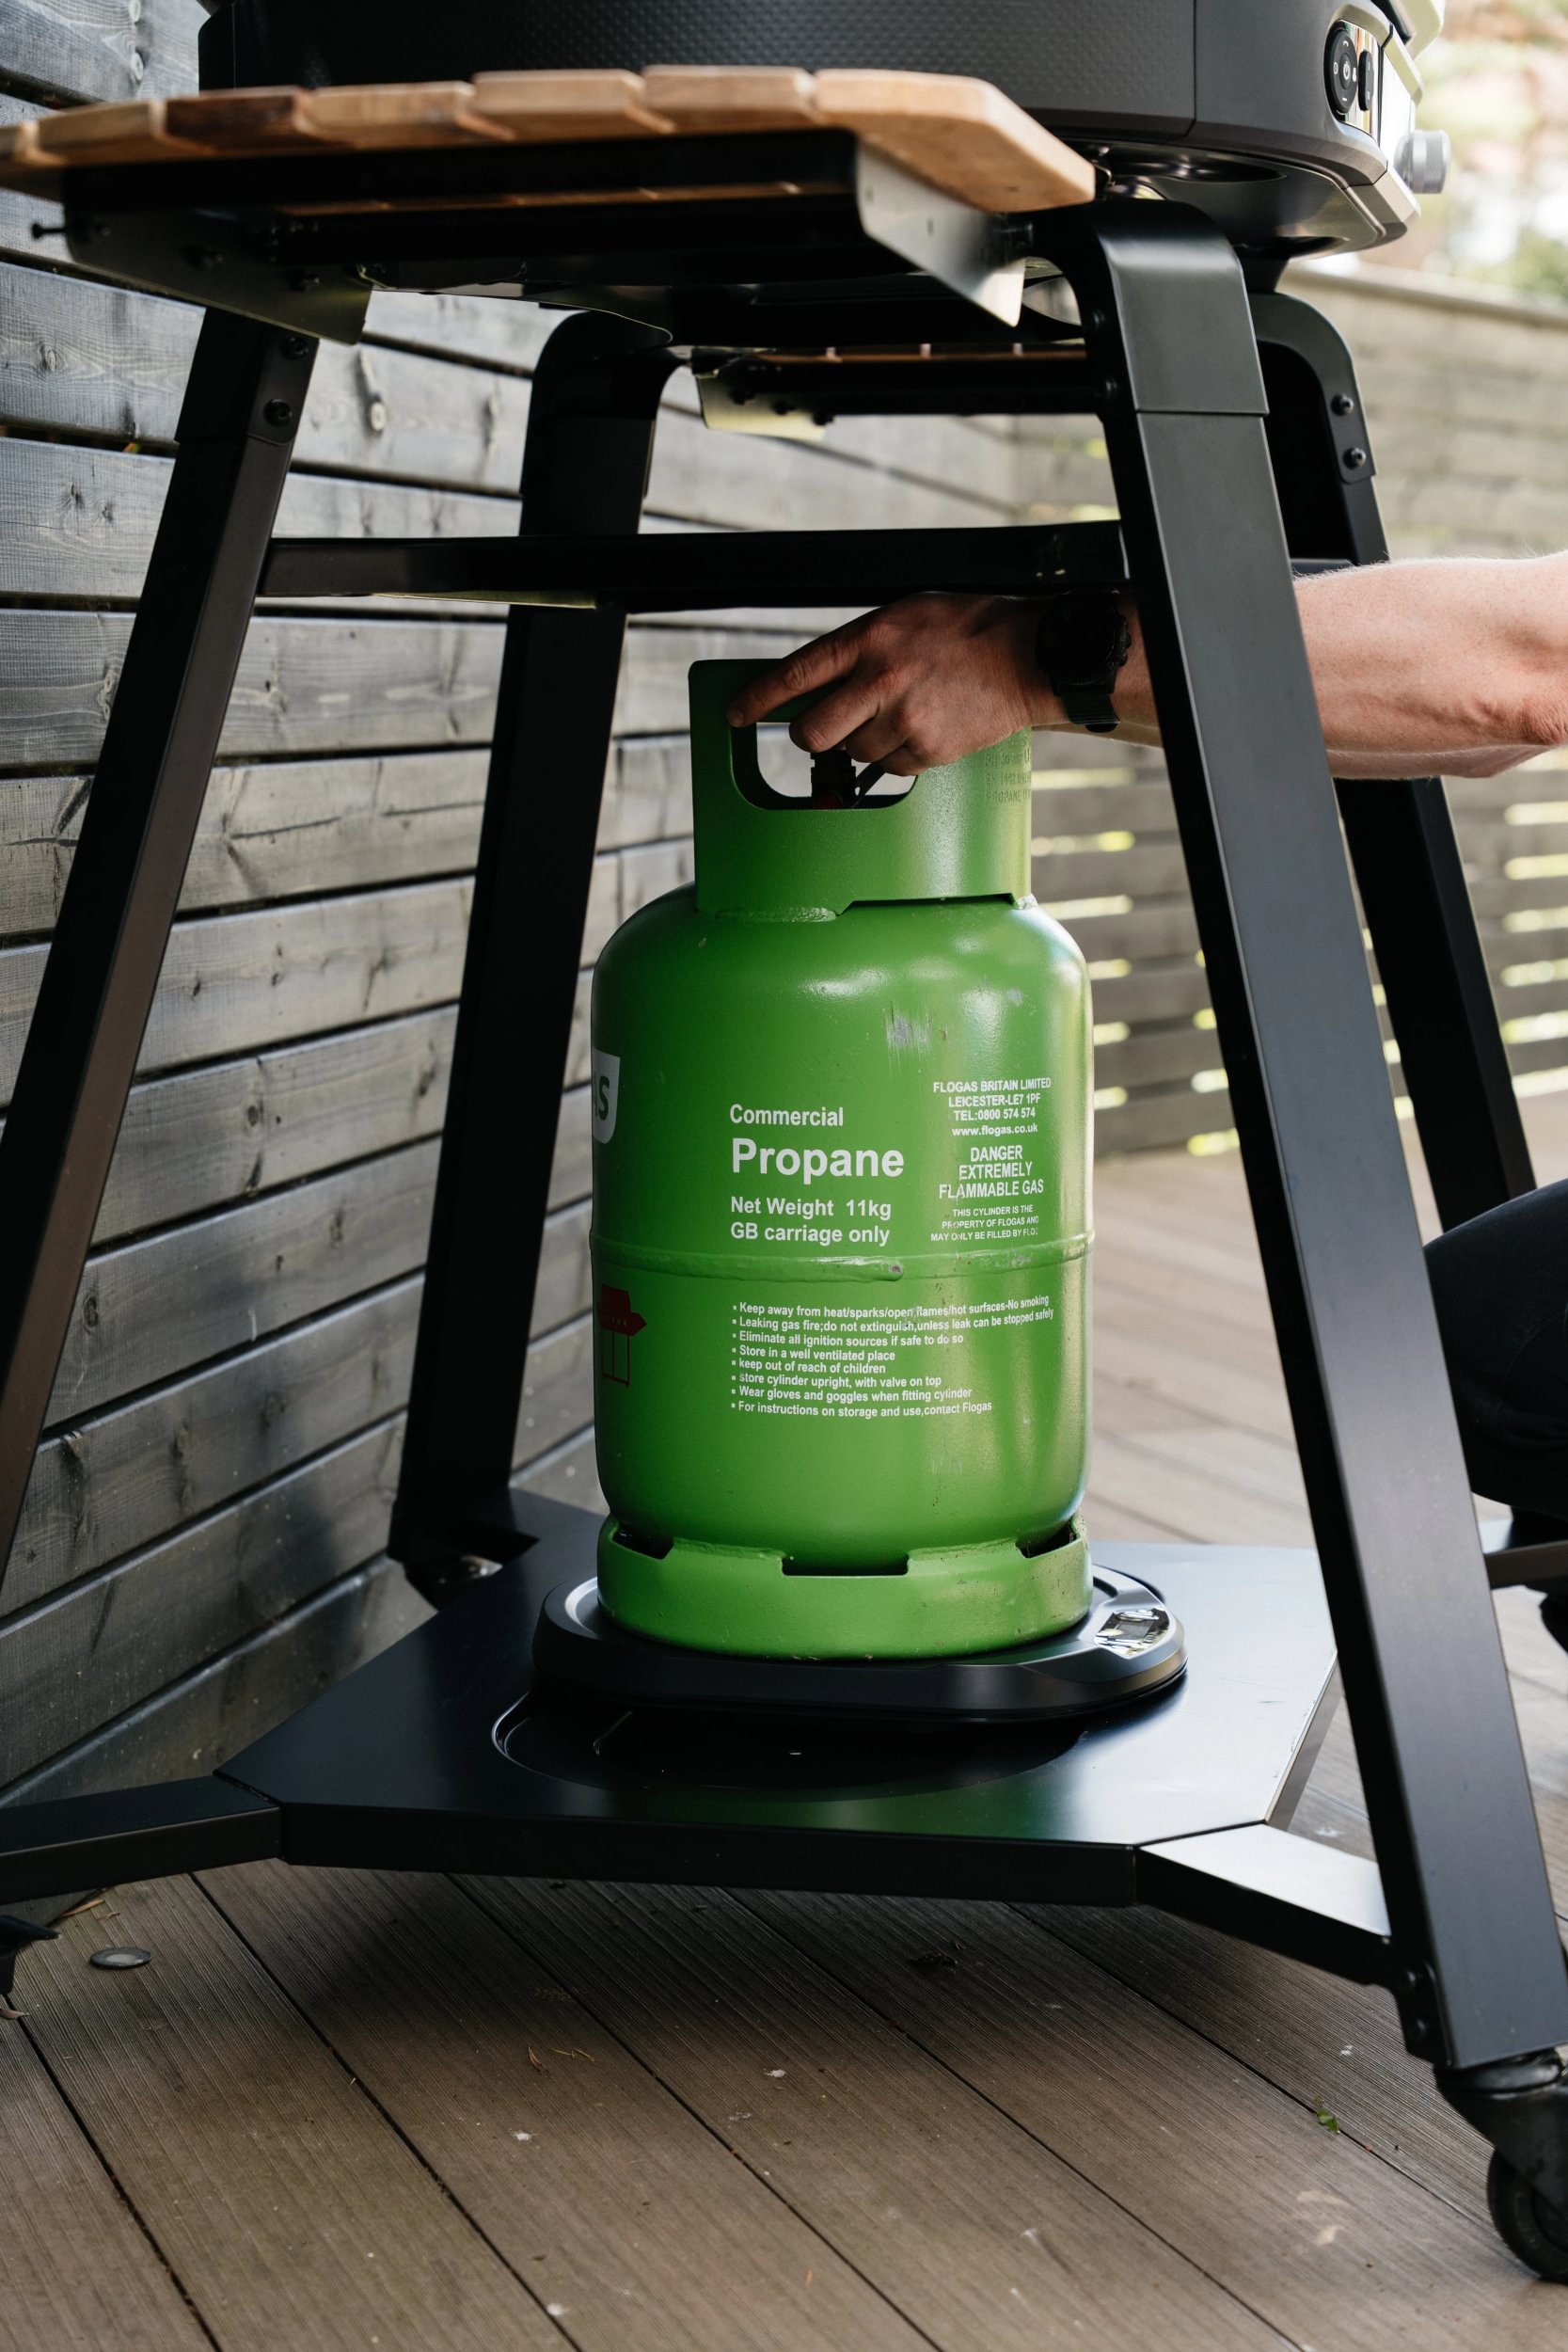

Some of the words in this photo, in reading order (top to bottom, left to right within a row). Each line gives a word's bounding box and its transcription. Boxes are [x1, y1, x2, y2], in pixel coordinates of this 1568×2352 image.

[933, 1081, 978, 1092] FLOGAS
[981, 1080, 1018, 1091] BRITAIN
[1021, 1077, 1051, 1089] LIMITED
[949, 1094, 1023, 1107] LEICESTER-LE7
[1026, 1093, 1041, 1104] 1PF
[730, 1104, 844, 1126] Commercial
[954, 1110, 1000, 1120] TEL:0800
[1004, 1108, 1019, 1119] 574
[1022, 1107, 1035, 1118] 574
[952, 1123, 1037, 1136] www.flogas.co.uk
[733, 1138, 904, 1184] Propane
[971, 1145, 1022, 1162] DANGER
[959, 1161, 1032, 1180] EXTREMELY
[939, 1181, 1019, 1199] FLAMMABLE
[1022, 1179, 1043, 1194] GAS
[731, 1197, 761, 1214] Net
[767, 1198, 833, 1219] Weight
[847, 1200, 891, 1220] 11kg
[974, 1207, 1010, 1216] CYLINDER
[1021, 1204, 1033, 1213] THE
[998, 1217, 1024, 1227] FLOGAS
[731, 1222, 758, 1239] GB
[765, 1225, 843, 1246] carriage
[849, 1226, 890, 1247] only
[952, 1232, 973, 1241] ONLY
[988, 1230, 1010, 1238] FILLED
[740, 1302, 764, 1315] Keep
[768, 1308, 793, 1317] away
[797, 1306, 820, 1316] from
[824, 1307, 913, 1320] heat/sparks/open
[916, 1305, 966, 1316] flames/hot
[969, 1299, 1019, 1313] surfaces-No
[1021, 1295, 1049, 1308] smoking
[740, 1316, 778, 1331] Leaking
[782, 1322, 800, 1331] gas
[803, 1320, 836, 1332] fire;do
[841, 1322, 857, 1331] not
[860, 1320, 949, 1334] extinguish,unless
[952, 1318, 971, 1328] leak
[974, 1318, 989, 1327] can
[991, 1316, 1001, 1326] be
[1004, 1311, 1034, 1325] stopped
[1036, 1308, 1053, 1321] safely
[740, 1330, 785, 1343] Eliminate
[788, 1334, 800, 1344] all
[804, 1334, 843, 1347] ignition
[846, 1338, 887, 1346] sources
[891, 1336, 898, 1345] if
[901, 1335, 921, 1345] safe
[925, 1335, 934, 1344] to
[938, 1334, 949, 1344] do
[952, 1335, 963, 1343] so
[740, 1345, 766, 1357] Store
[769, 1347, 777, 1357] in
[790, 1349, 810, 1359] well
[814, 1349, 864, 1360] ventilated
[867, 1351, 895, 1362] place
[739, 1358, 762, 1371] keep
[766, 1360, 782, 1370] out
[784, 1361, 795, 1372] of
[798, 1361, 826, 1373] reach
[830, 1362, 840, 1373] of
[844, 1362, 885, 1374] children
[768, 1375, 808, 1387] cylinder
[812, 1376, 851, 1390] upright,
[855, 1377, 877, 1388] with
[880, 1376, 907, 1387] valve
[910, 1377, 922, 1386] on
[926, 1376, 941, 1390] top
[739, 1386, 764, 1397] Wear
[768, 1388, 800, 1400] gloves
[804, 1391, 823, 1400] and
[827, 1391, 868, 1404] goggles
[872, 1391, 898, 1402] when
[903, 1390, 930, 1402] fitting
[934, 1389, 972, 1401] cylinder
[738, 1401, 754, 1411] For
[758, 1402, 818, 1416] instructions
[822, 1407, 834, 1416] on
[838, 1406, 877, 1419] storage
[880, 1406, 899, 1416] and
[903, 1404, 959, 1417] use,contact
[963, 1402, 991, 1413] Flogas
